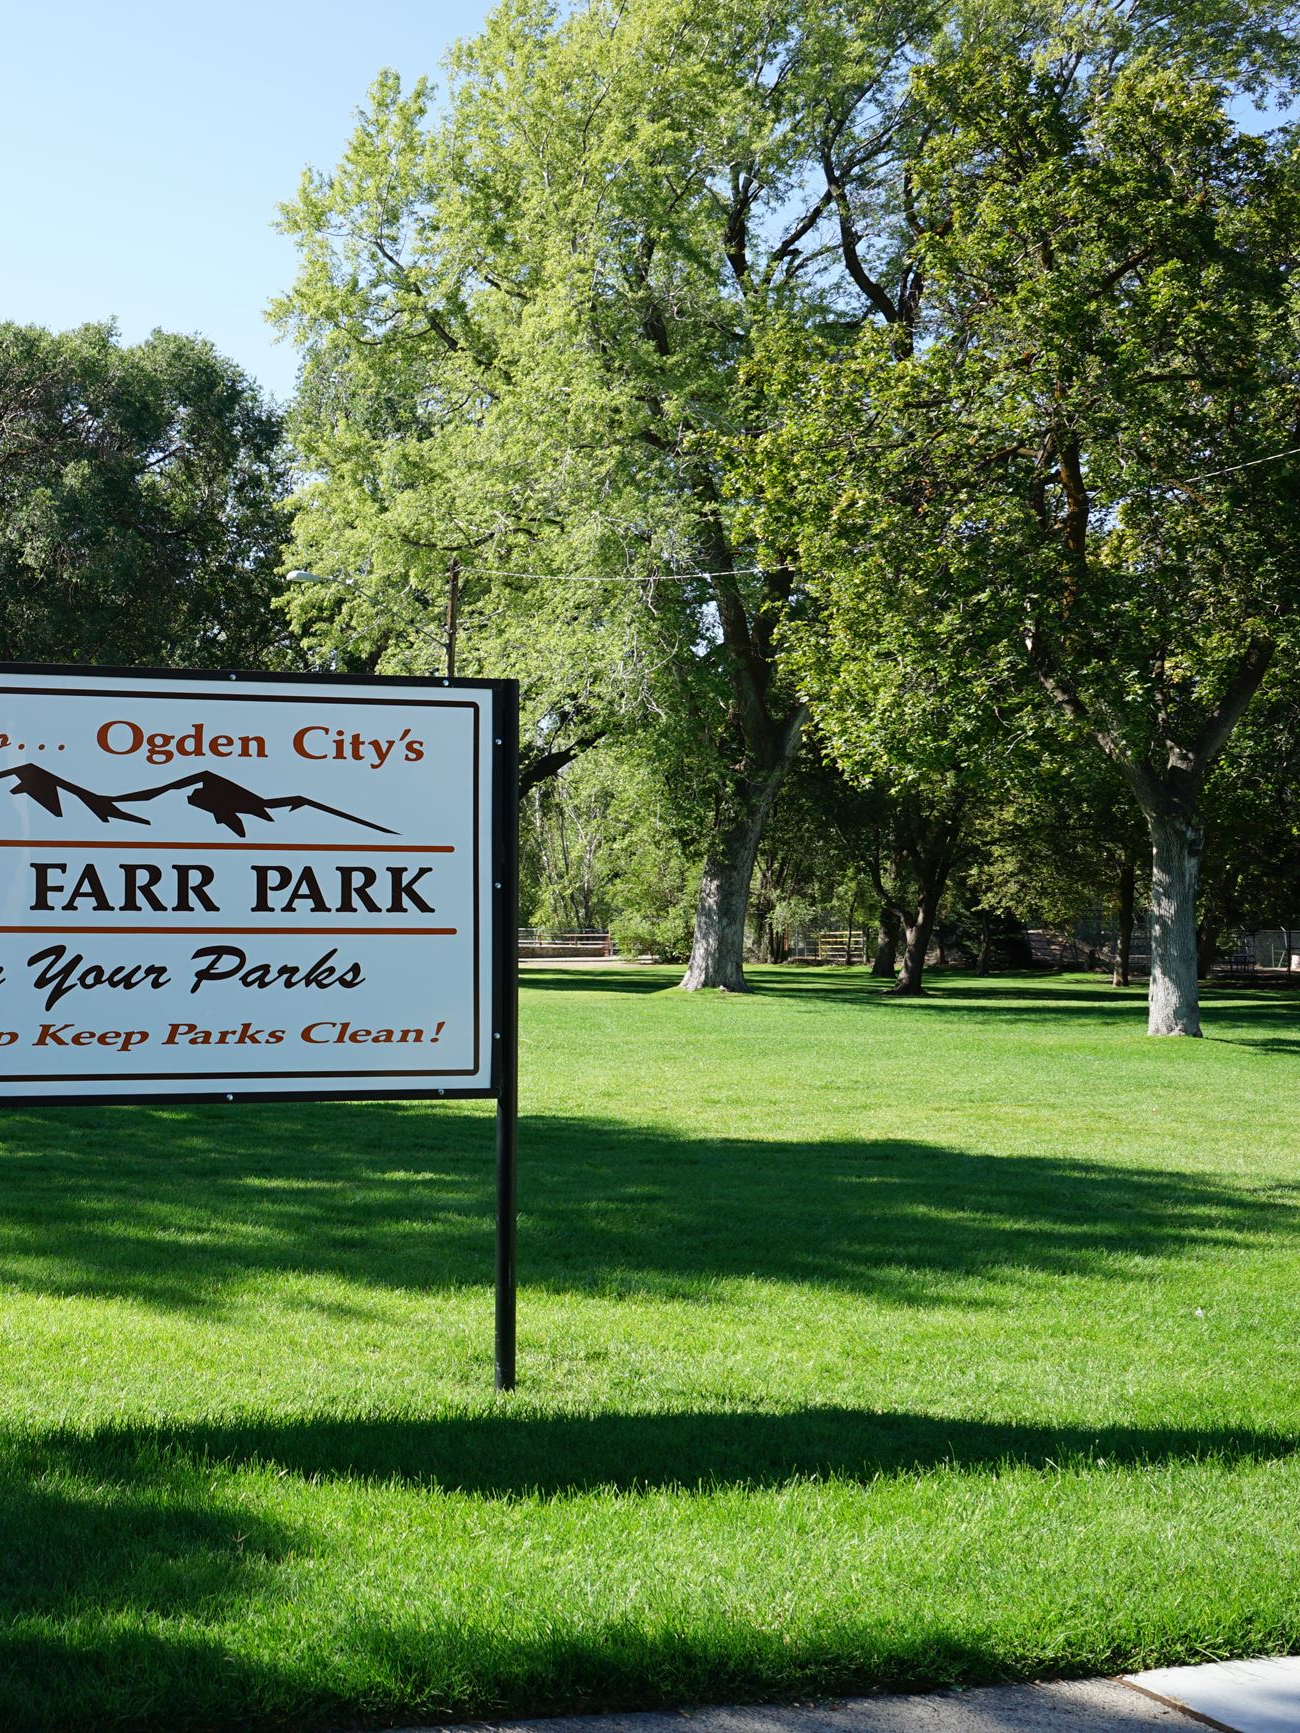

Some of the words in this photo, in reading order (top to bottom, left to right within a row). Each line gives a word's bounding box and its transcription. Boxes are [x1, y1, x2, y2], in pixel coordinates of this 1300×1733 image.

[97, 720, 268, 765] Ogden
[293, 726, 424, 769] City's
[30, 863, 220, 912] FARR
[251, 865, 435, 913] PARK
[27, 945, 171, 1012] Your
[190, 945, 366, 994] Parks
[32, 1024, 149, 1051] Keep
[161, 1023, 286, 1045] Parks
[301, 1021, 445, 1044] Clean!
